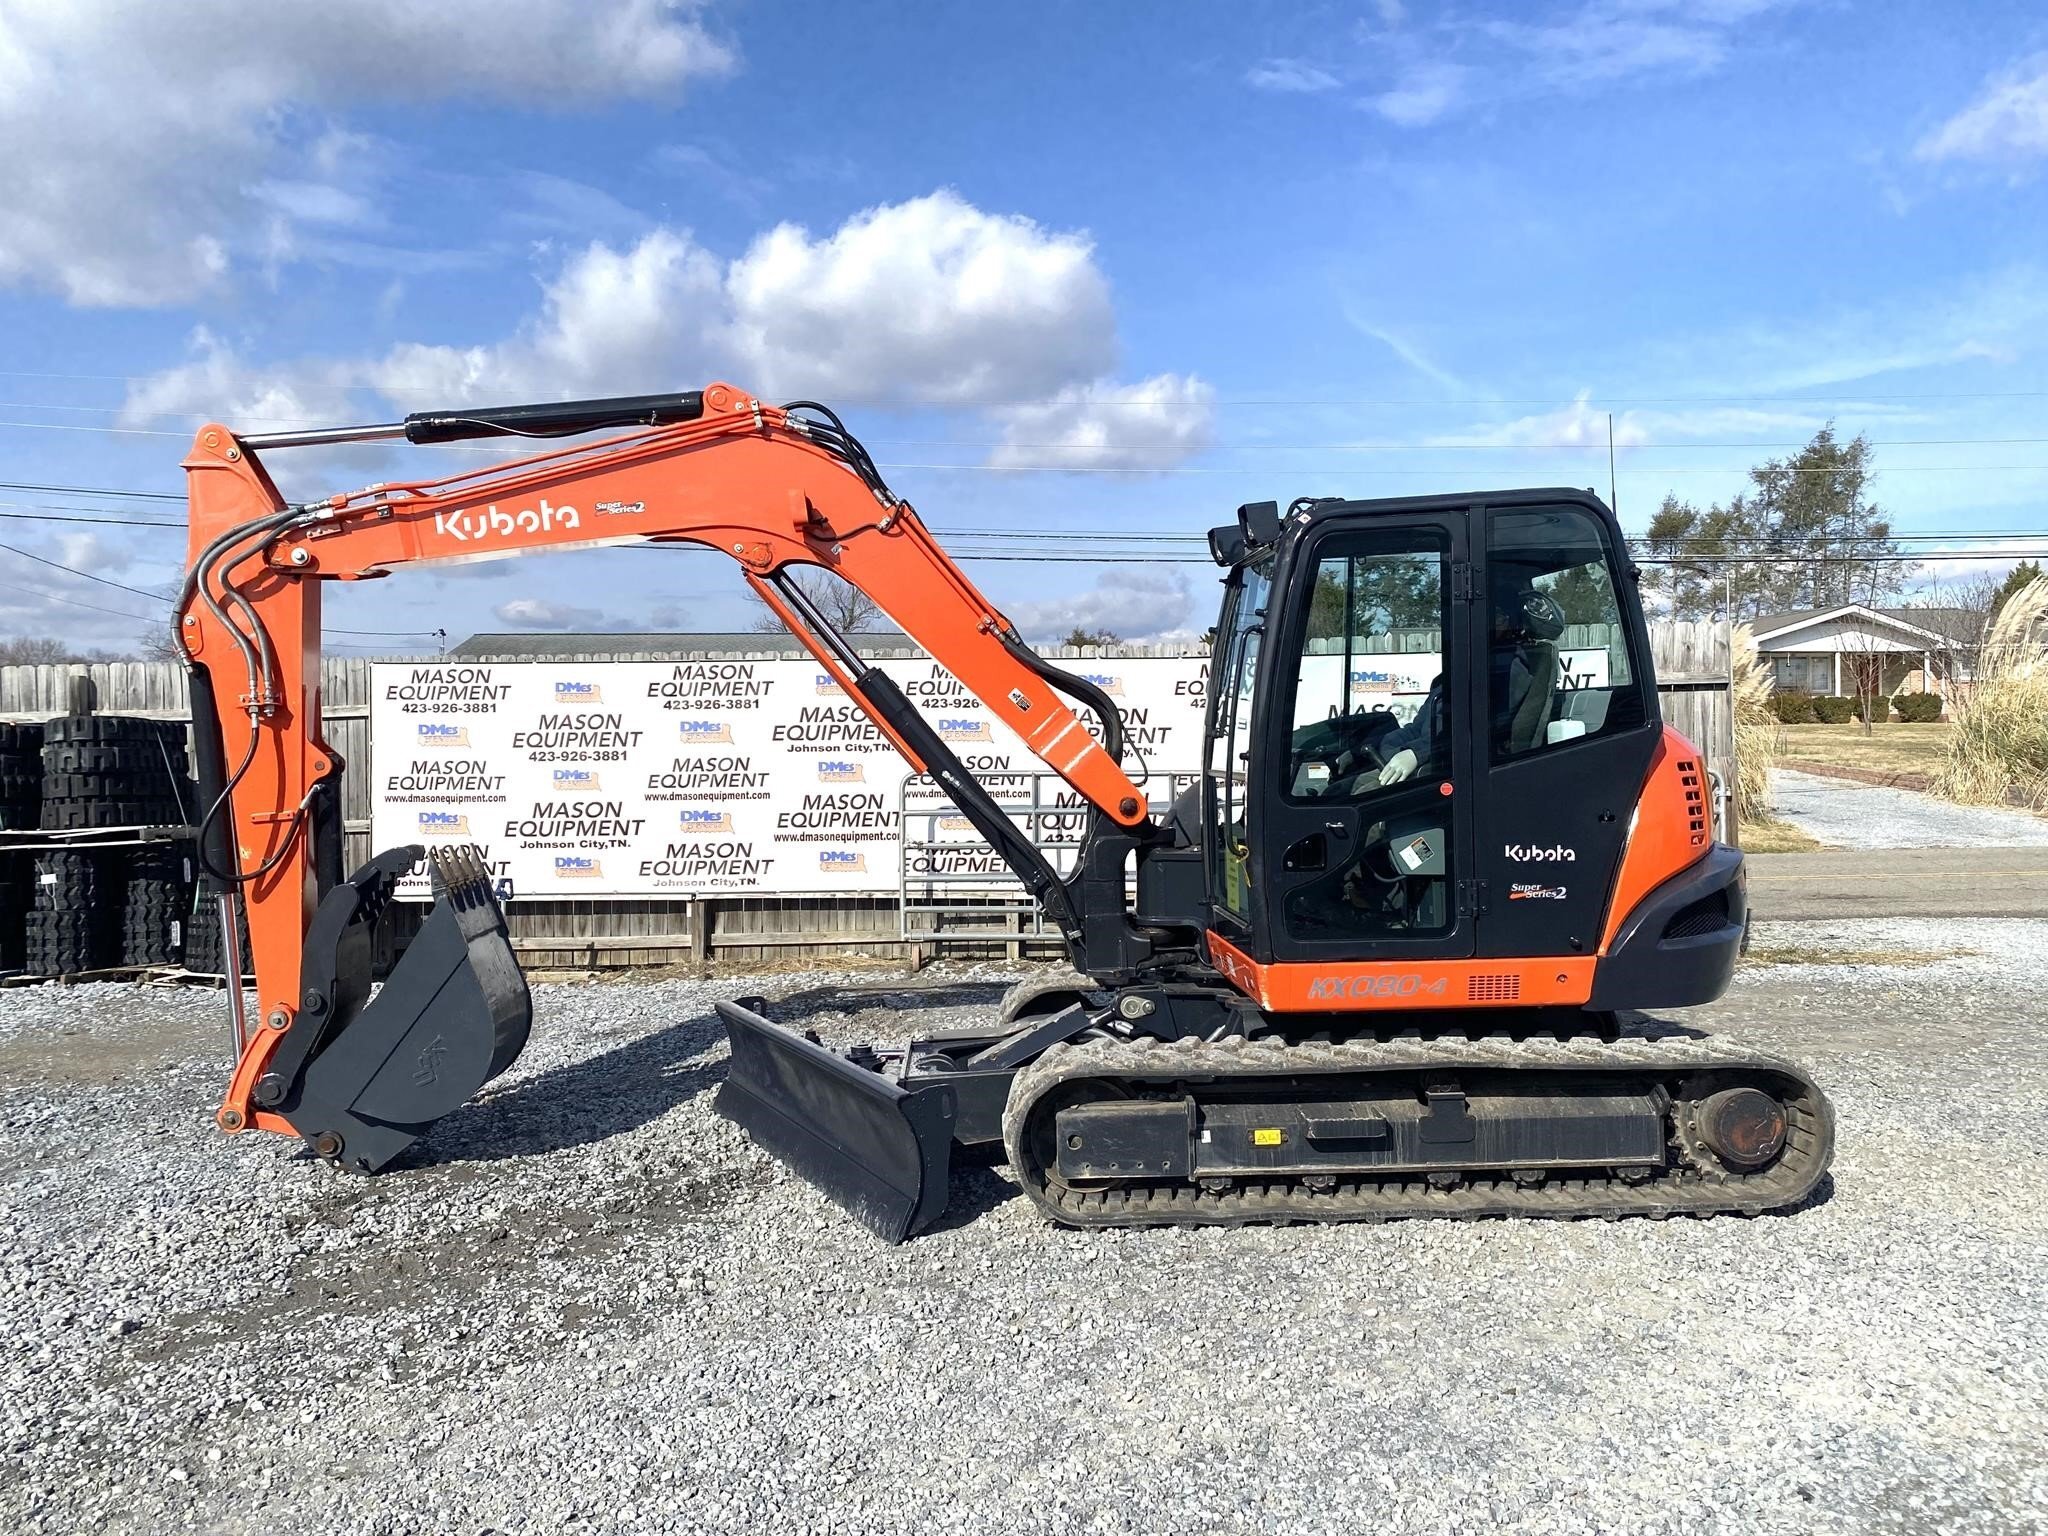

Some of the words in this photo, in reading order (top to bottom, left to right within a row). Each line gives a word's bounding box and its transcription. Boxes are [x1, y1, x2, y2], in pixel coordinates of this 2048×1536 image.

[435, 499, 580, 541] Kubota
[411, 669, 491, 684] MASON
[673, 664, 754, 680] MASON
[386, 686, 511, 701] EQUIPMENT
[647, 680, 774, 697] EQUIPMENT
[402, 703, 497, 713] 423-926-3881
[663, 698, 760, 710] 423-926-3881
[922, 698, 982, 708] 423-926-
[539, 714, 622, 730] MASON
[800, 706, 868, 723] MASO
[512, 731, 643, 748] EQUIPMENT
[772, 724, 881, 741] EQUIPME
[529, 750, 628, 761] 423-926-3881
[787, 744, 841, 752] Johnson
[411, 761, 486, 774] MASON
[672, 757, 750, 772] MASON
[387, 776, 506, 790] EQUIPMENT
[648, 773, 770, 788] EQUIPMENT
[384, 794, 506, 804] www.dmasonequipment.com
[644, 791, 771, 802] www.dmasonequipment.com
[802, 793, 884, 810] MASON
[532, 801, 622, 818] MASON
[777, 811, 900, 828] EQUIPMENT
[504, 820, 645, 837] EQUIPMENT
[520, 840, 575, 848] Johnson
[666, 842, 753, 859] MASON
[1505, 844, 1576, 861] Kubota
[639, 859, 775, 876] EQUIPMENT
[653, 879, 706, 887] Johnson
[1510, 883, 1542, 892] Super
[1308, 975, 1447, 999] KX080-4
